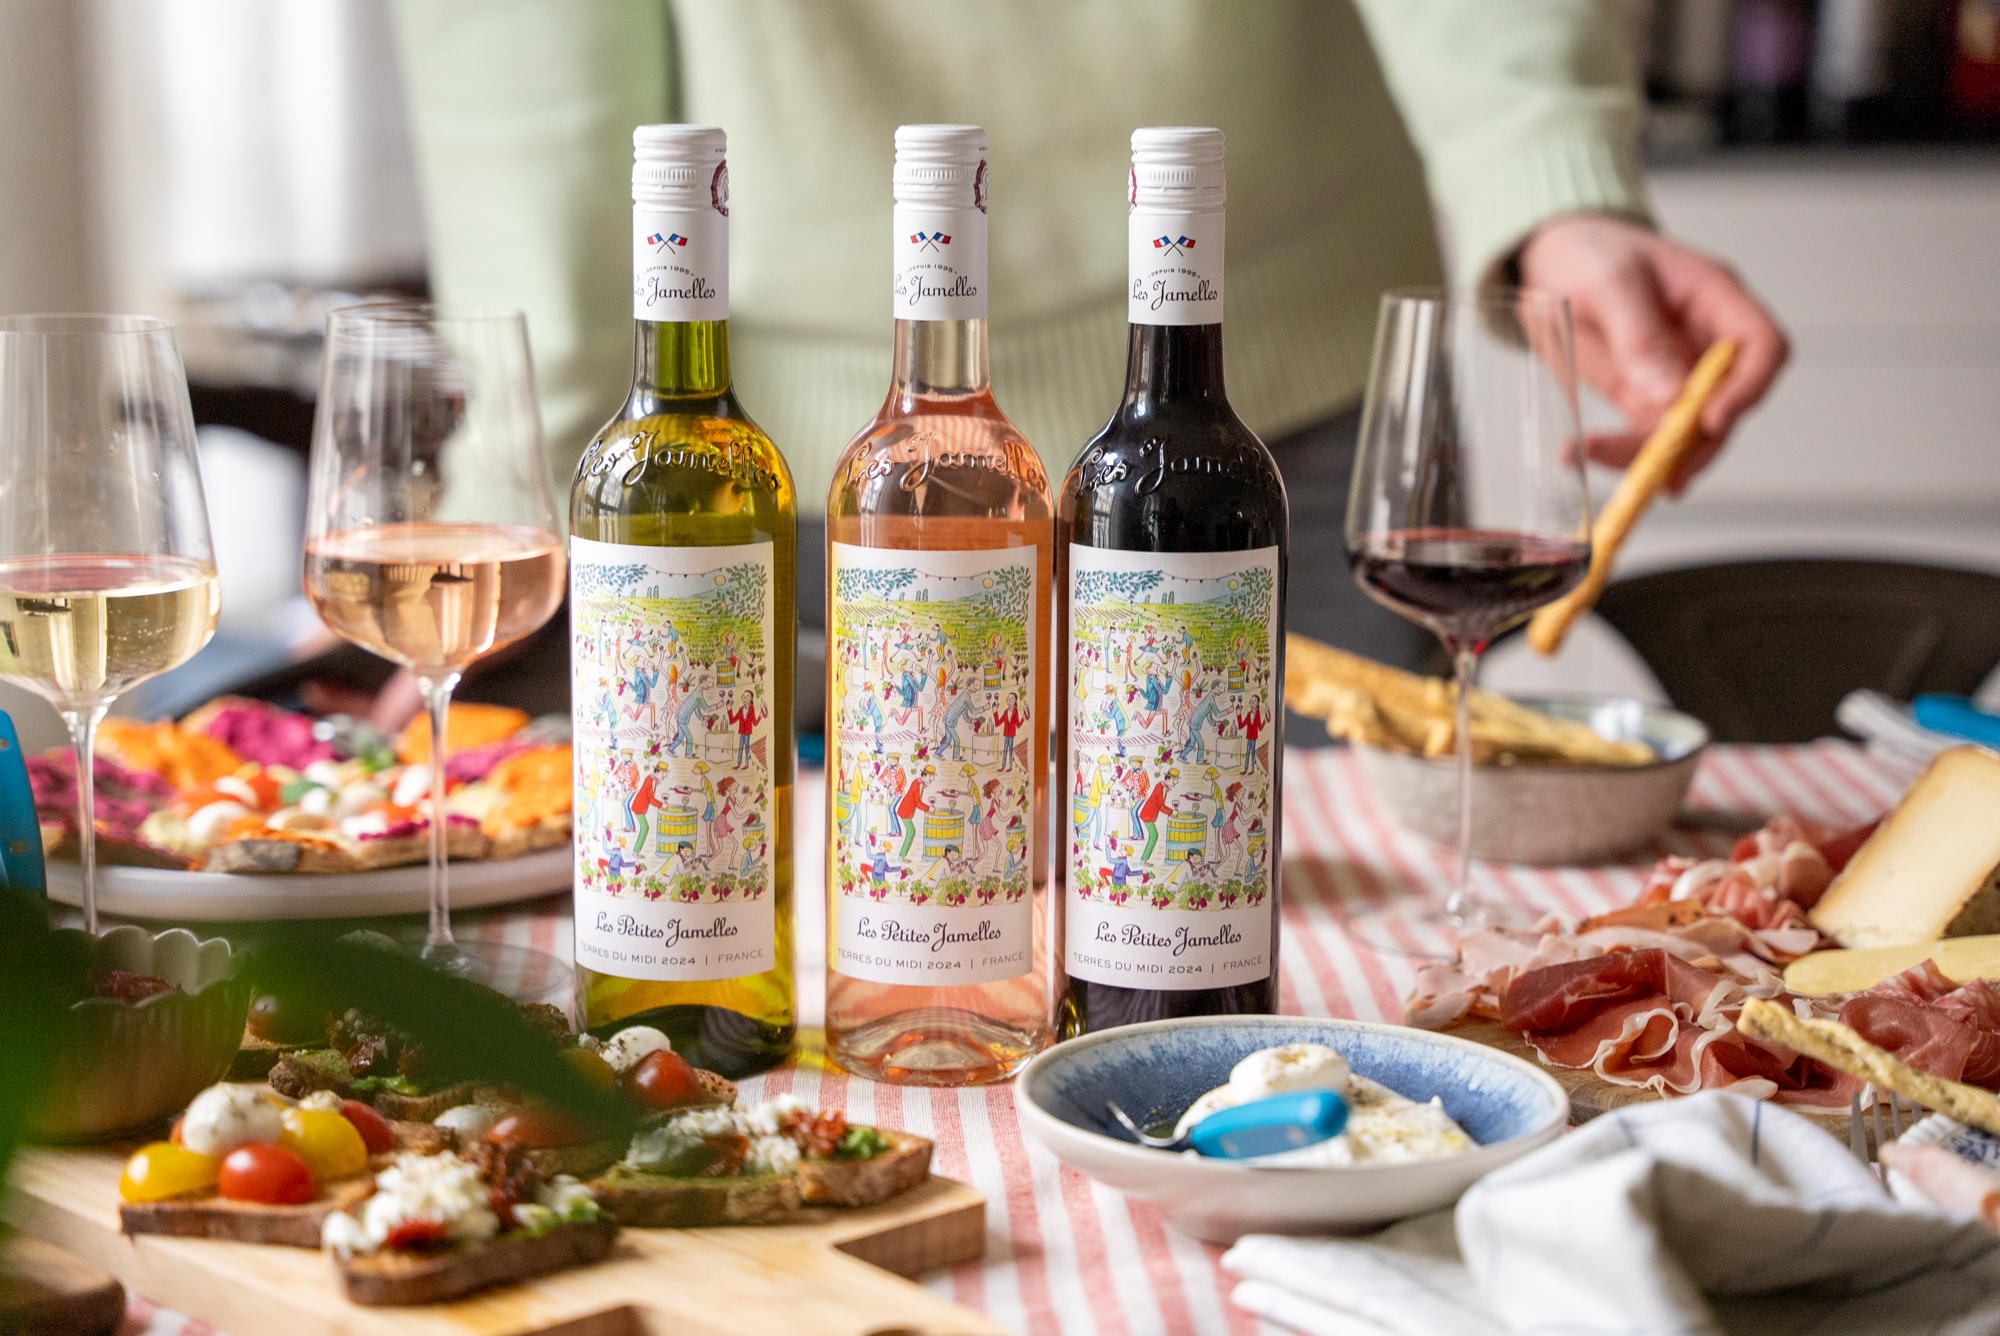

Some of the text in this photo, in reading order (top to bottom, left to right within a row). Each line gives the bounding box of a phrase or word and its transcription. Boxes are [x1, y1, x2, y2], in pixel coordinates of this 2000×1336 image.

[646, 276, 716, 307] Jamelles
[909, 275, 977, 306] Jamelles
[1132, 278, 1218, 311] Les Jamelles
[595, 911, 738, 948] Les Petites Jamelles
[857, 917, 1001, 952] Les Petites Jamelles
[1095, 921, 1242, 957] Les Petites Jamelles
[580, 941, 610, 959] TERRES
[612, 951, 627, 961] DU
[631, 953, 657, 965] MIDI
[661, 956, 696, 965] 2024
[717, 948, 764, 963] FRANCE
[838, 948, 872, 965] TERRES
[875, 957, 891, 967] DU
[896, 960, 922, 970] MIDI
[927, 961, 961, 970] 2024
[982, 951, 1024, 967] FRANCE
[1073, 952, 1111, 969] TERRES
[1115, 961, 1131, 972] DU
[1136, 964, 1163, 974] MIDI
[1168, 965, 1203, 974] 2024
[1222, 955, 1262, 971] FRANCE
